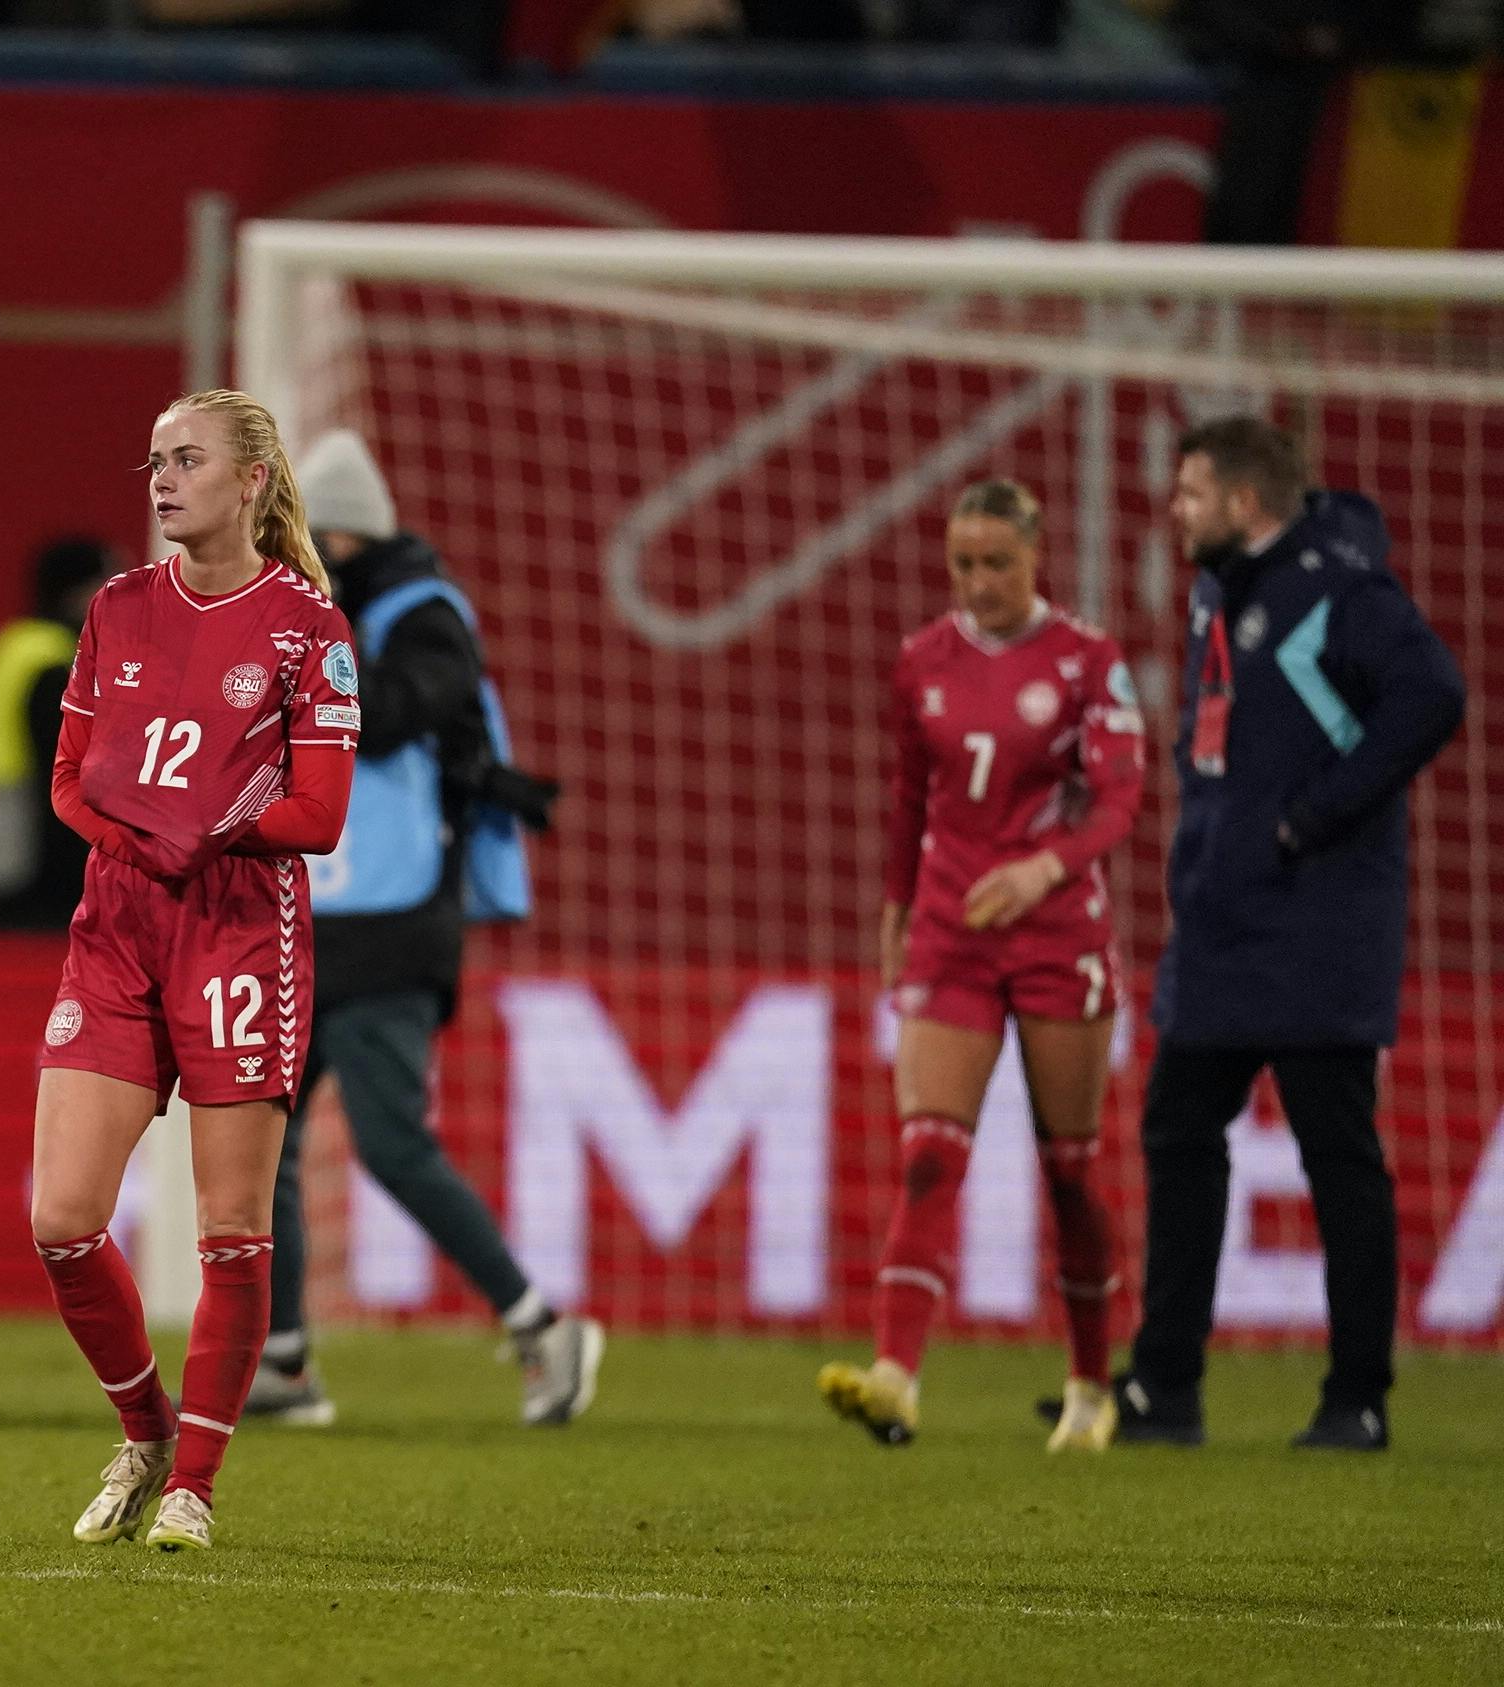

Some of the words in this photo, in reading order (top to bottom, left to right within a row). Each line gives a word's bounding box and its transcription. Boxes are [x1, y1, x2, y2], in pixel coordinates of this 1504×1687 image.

[232, 678, 260, 692] DBU
[137, 717, 202, 789] 12
[963, 732, 995, 801] 7
[202, 974, 266, 1049] 12
[1076, 953, 1106, 1020] 7
[52, 1014, 76, 1029] DBU
[236, 1072, 265, 1084] hummel
